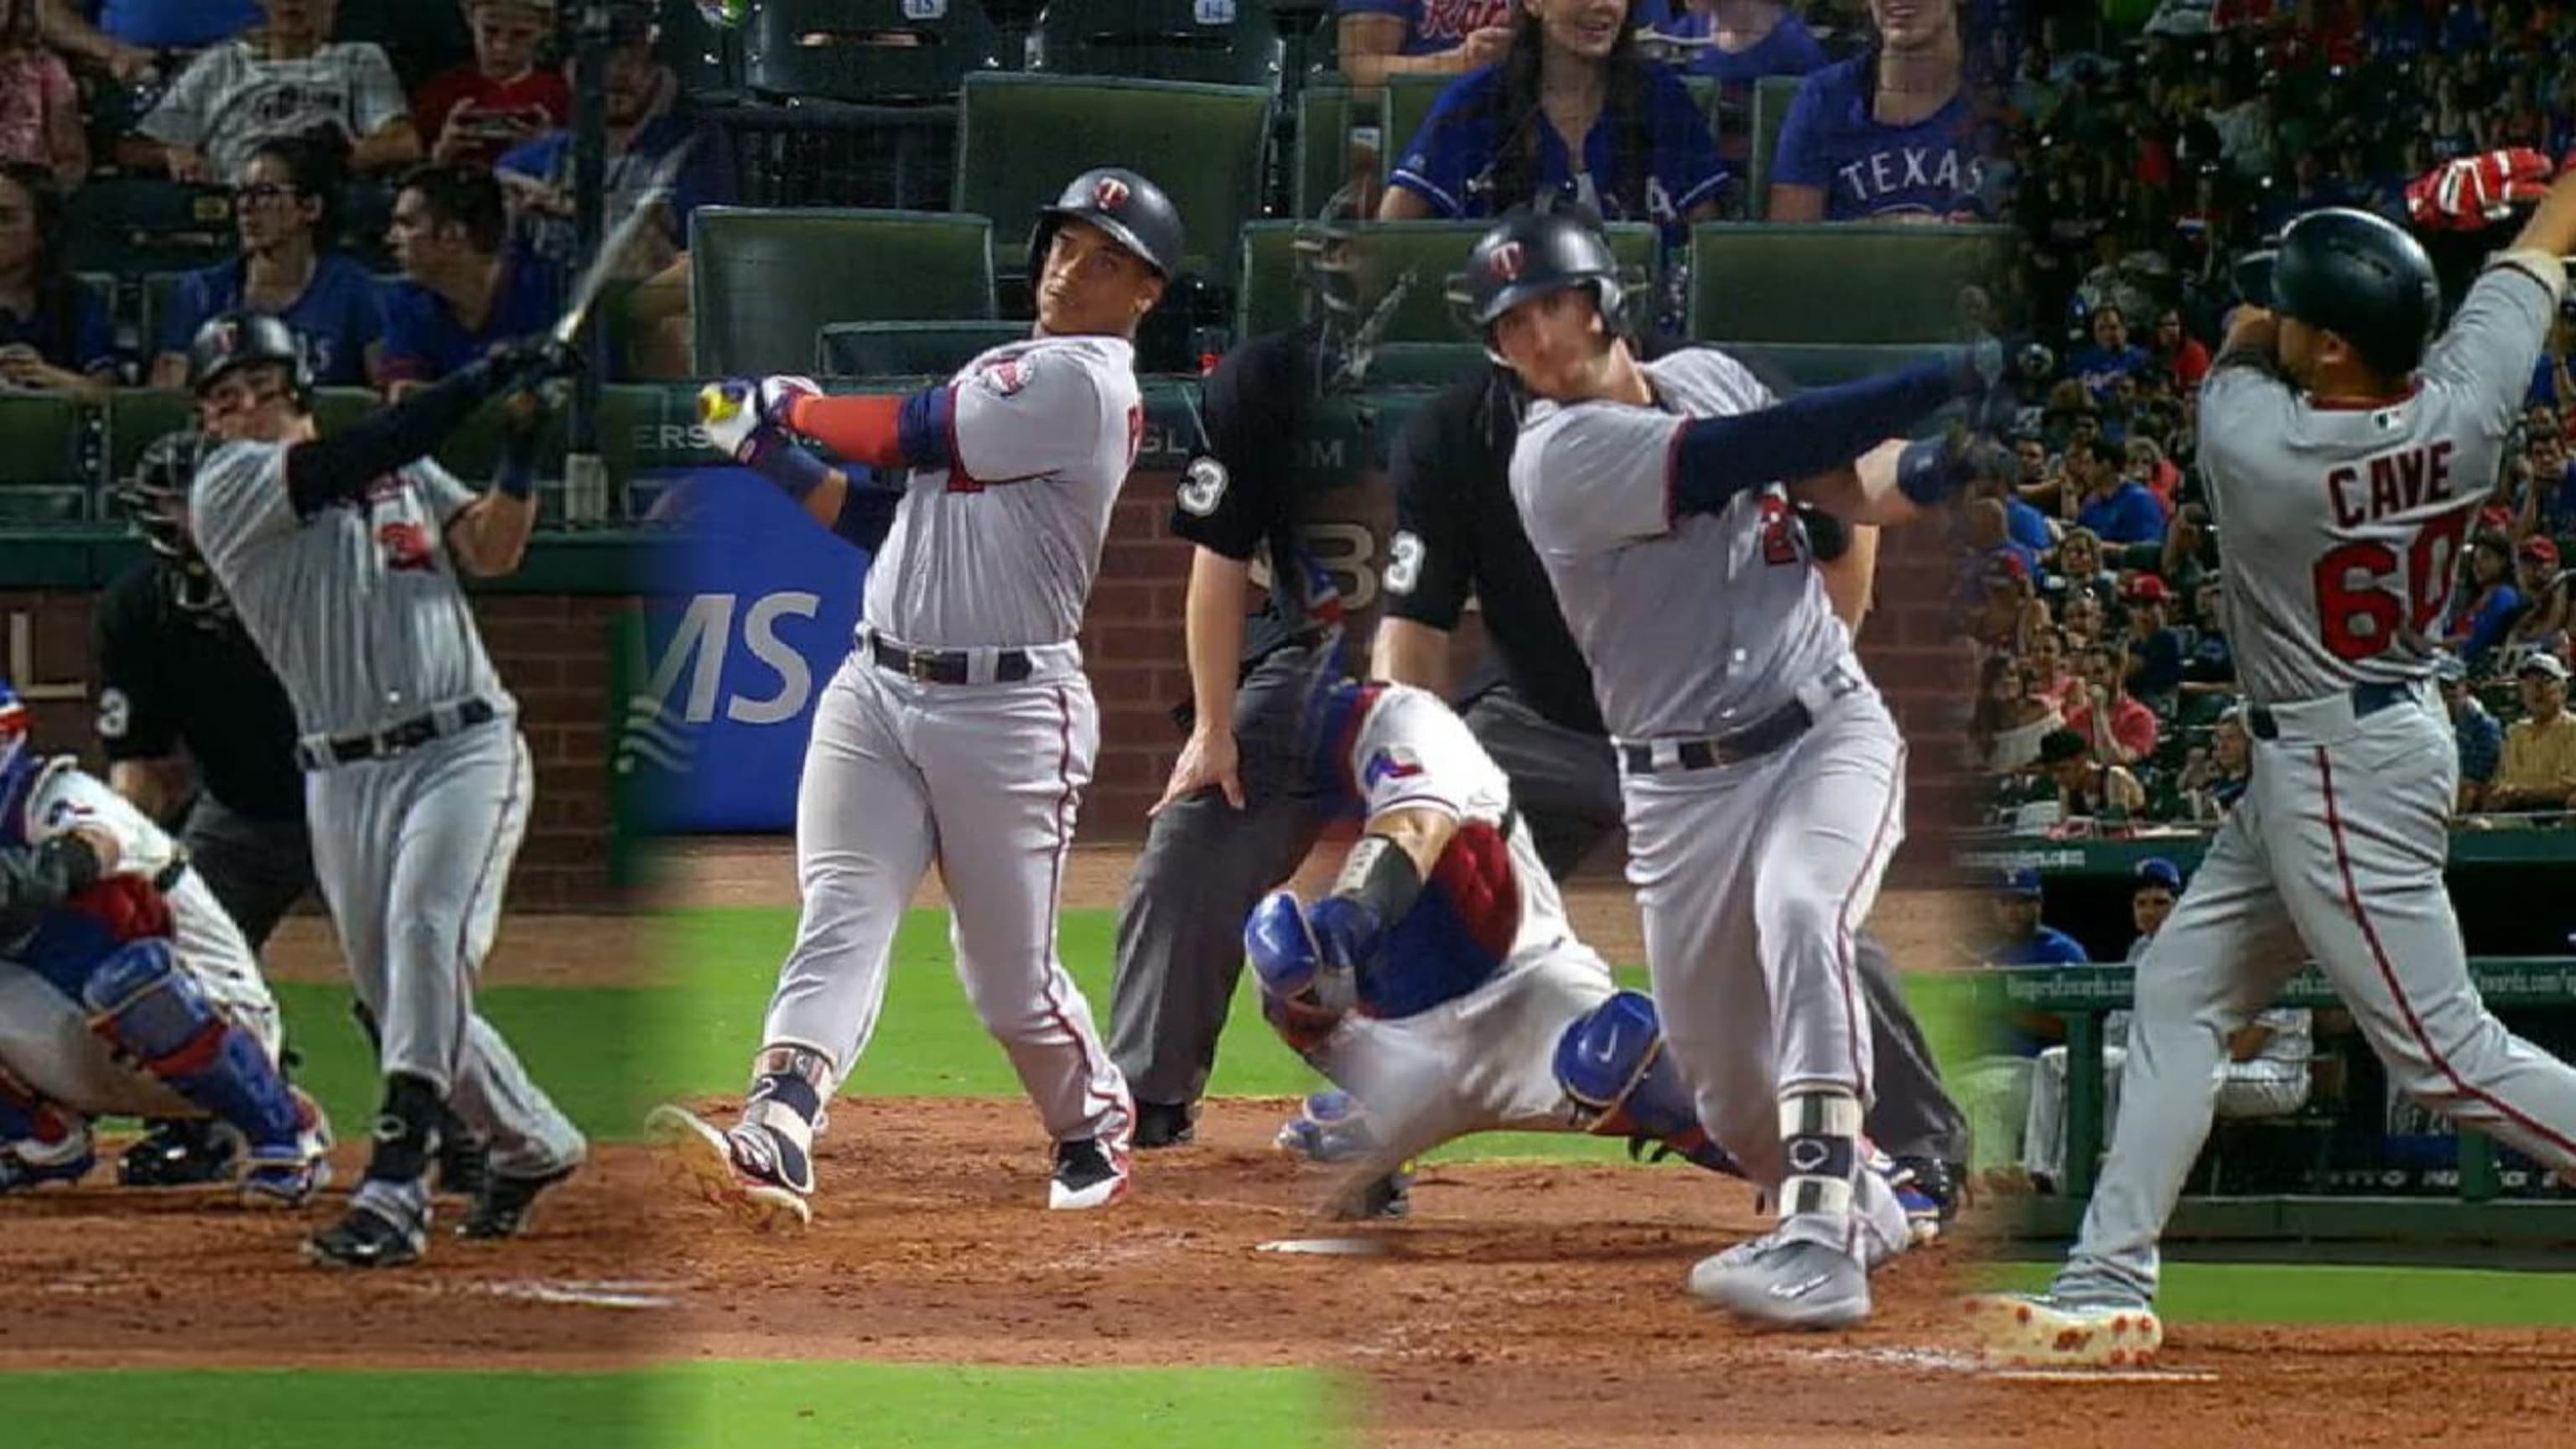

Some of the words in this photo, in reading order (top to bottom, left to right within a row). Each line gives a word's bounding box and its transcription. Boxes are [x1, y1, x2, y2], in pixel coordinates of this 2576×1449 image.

[1839, 148, 1987, 201] TEXAS
[1177, 455, 1229, 517] 3
[2328, 439, 2453, 529] CAVE
[1382, 530, 1426, 595] 3
[2313, 508, 2468, 662] 60
[95, 688, 129, 739] 3
